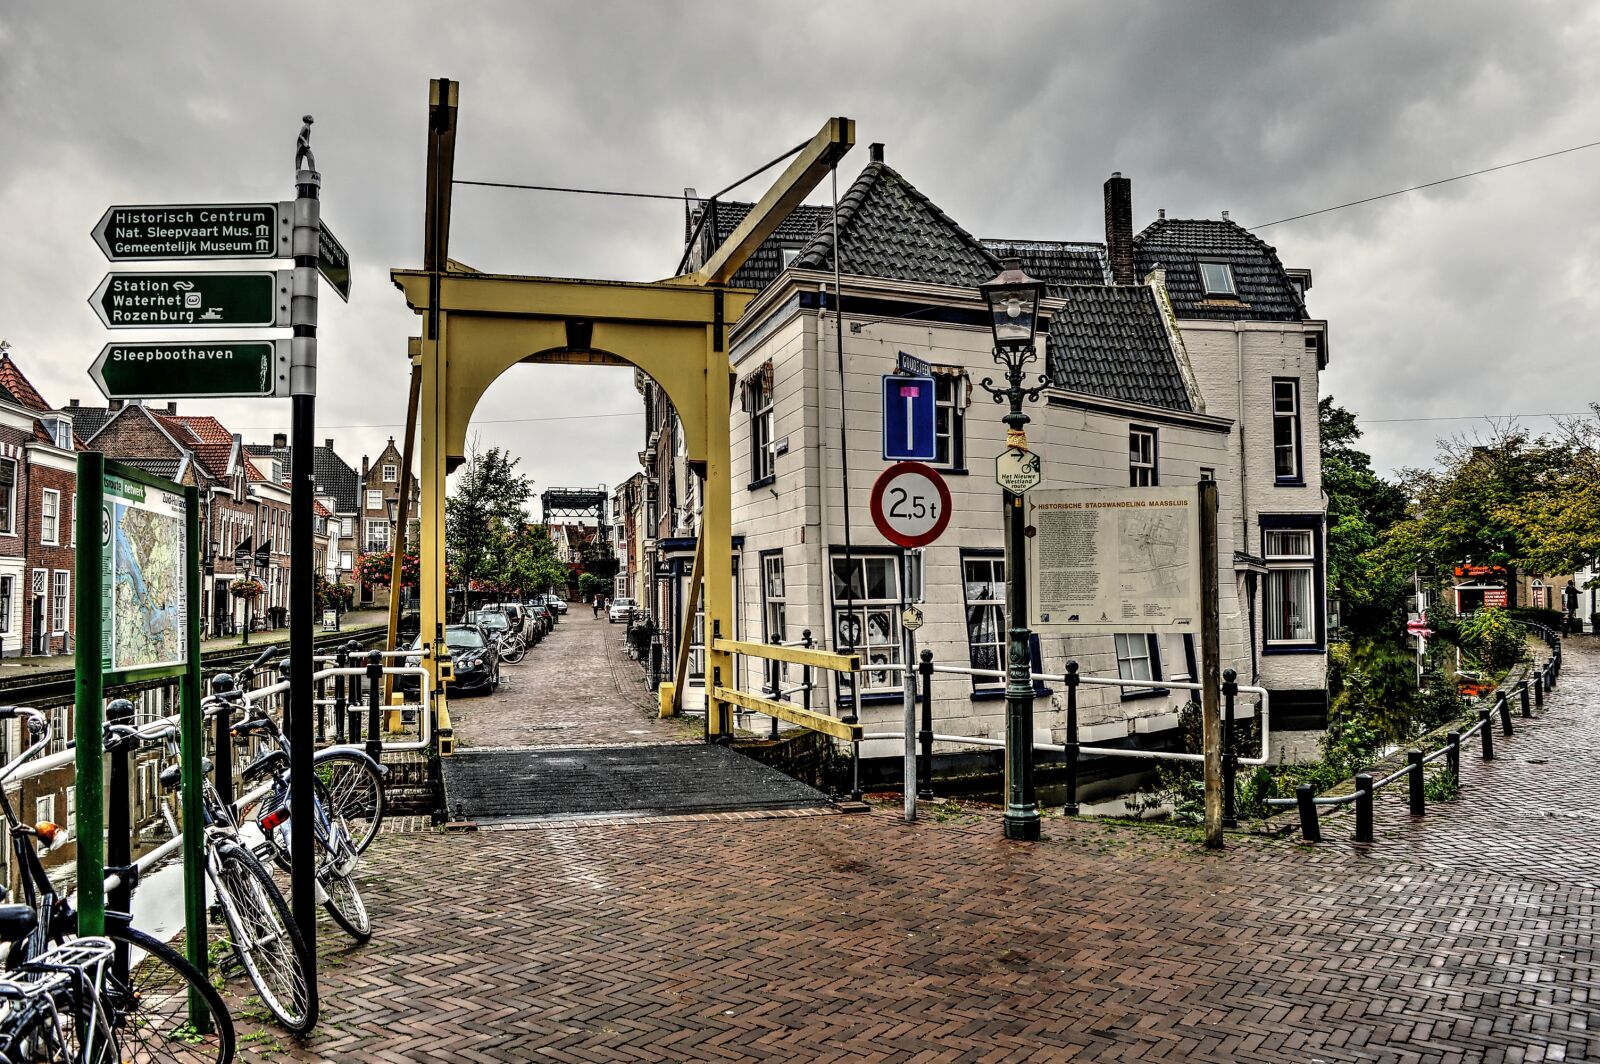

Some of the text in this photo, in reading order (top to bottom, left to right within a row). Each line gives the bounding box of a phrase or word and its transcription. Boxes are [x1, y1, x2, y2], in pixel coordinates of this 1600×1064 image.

[116, 211, 265, 223] Historisch Centrum
[115, 225, 252, 239] Nat. Sleepvaart Mus.
[115, 240, 252, 255] Gemeentelijk Museum
[113, 280, 169, 292] Station
[113, 294, 181, 306] Waternet
[113, 309, 194, 323] Rozenburg
[113, 348, 233, 362] Sleepboothaven
[902, 355, 931, 377] GOUDSTEEN
[124, 484, 144, 498] netwerk
[889, 487, 937, 520] 2,5 t
[1038, 502, 1082, 510] HISTORISCHE
[1085, 501, 1146, 509] STADSWANDELING
